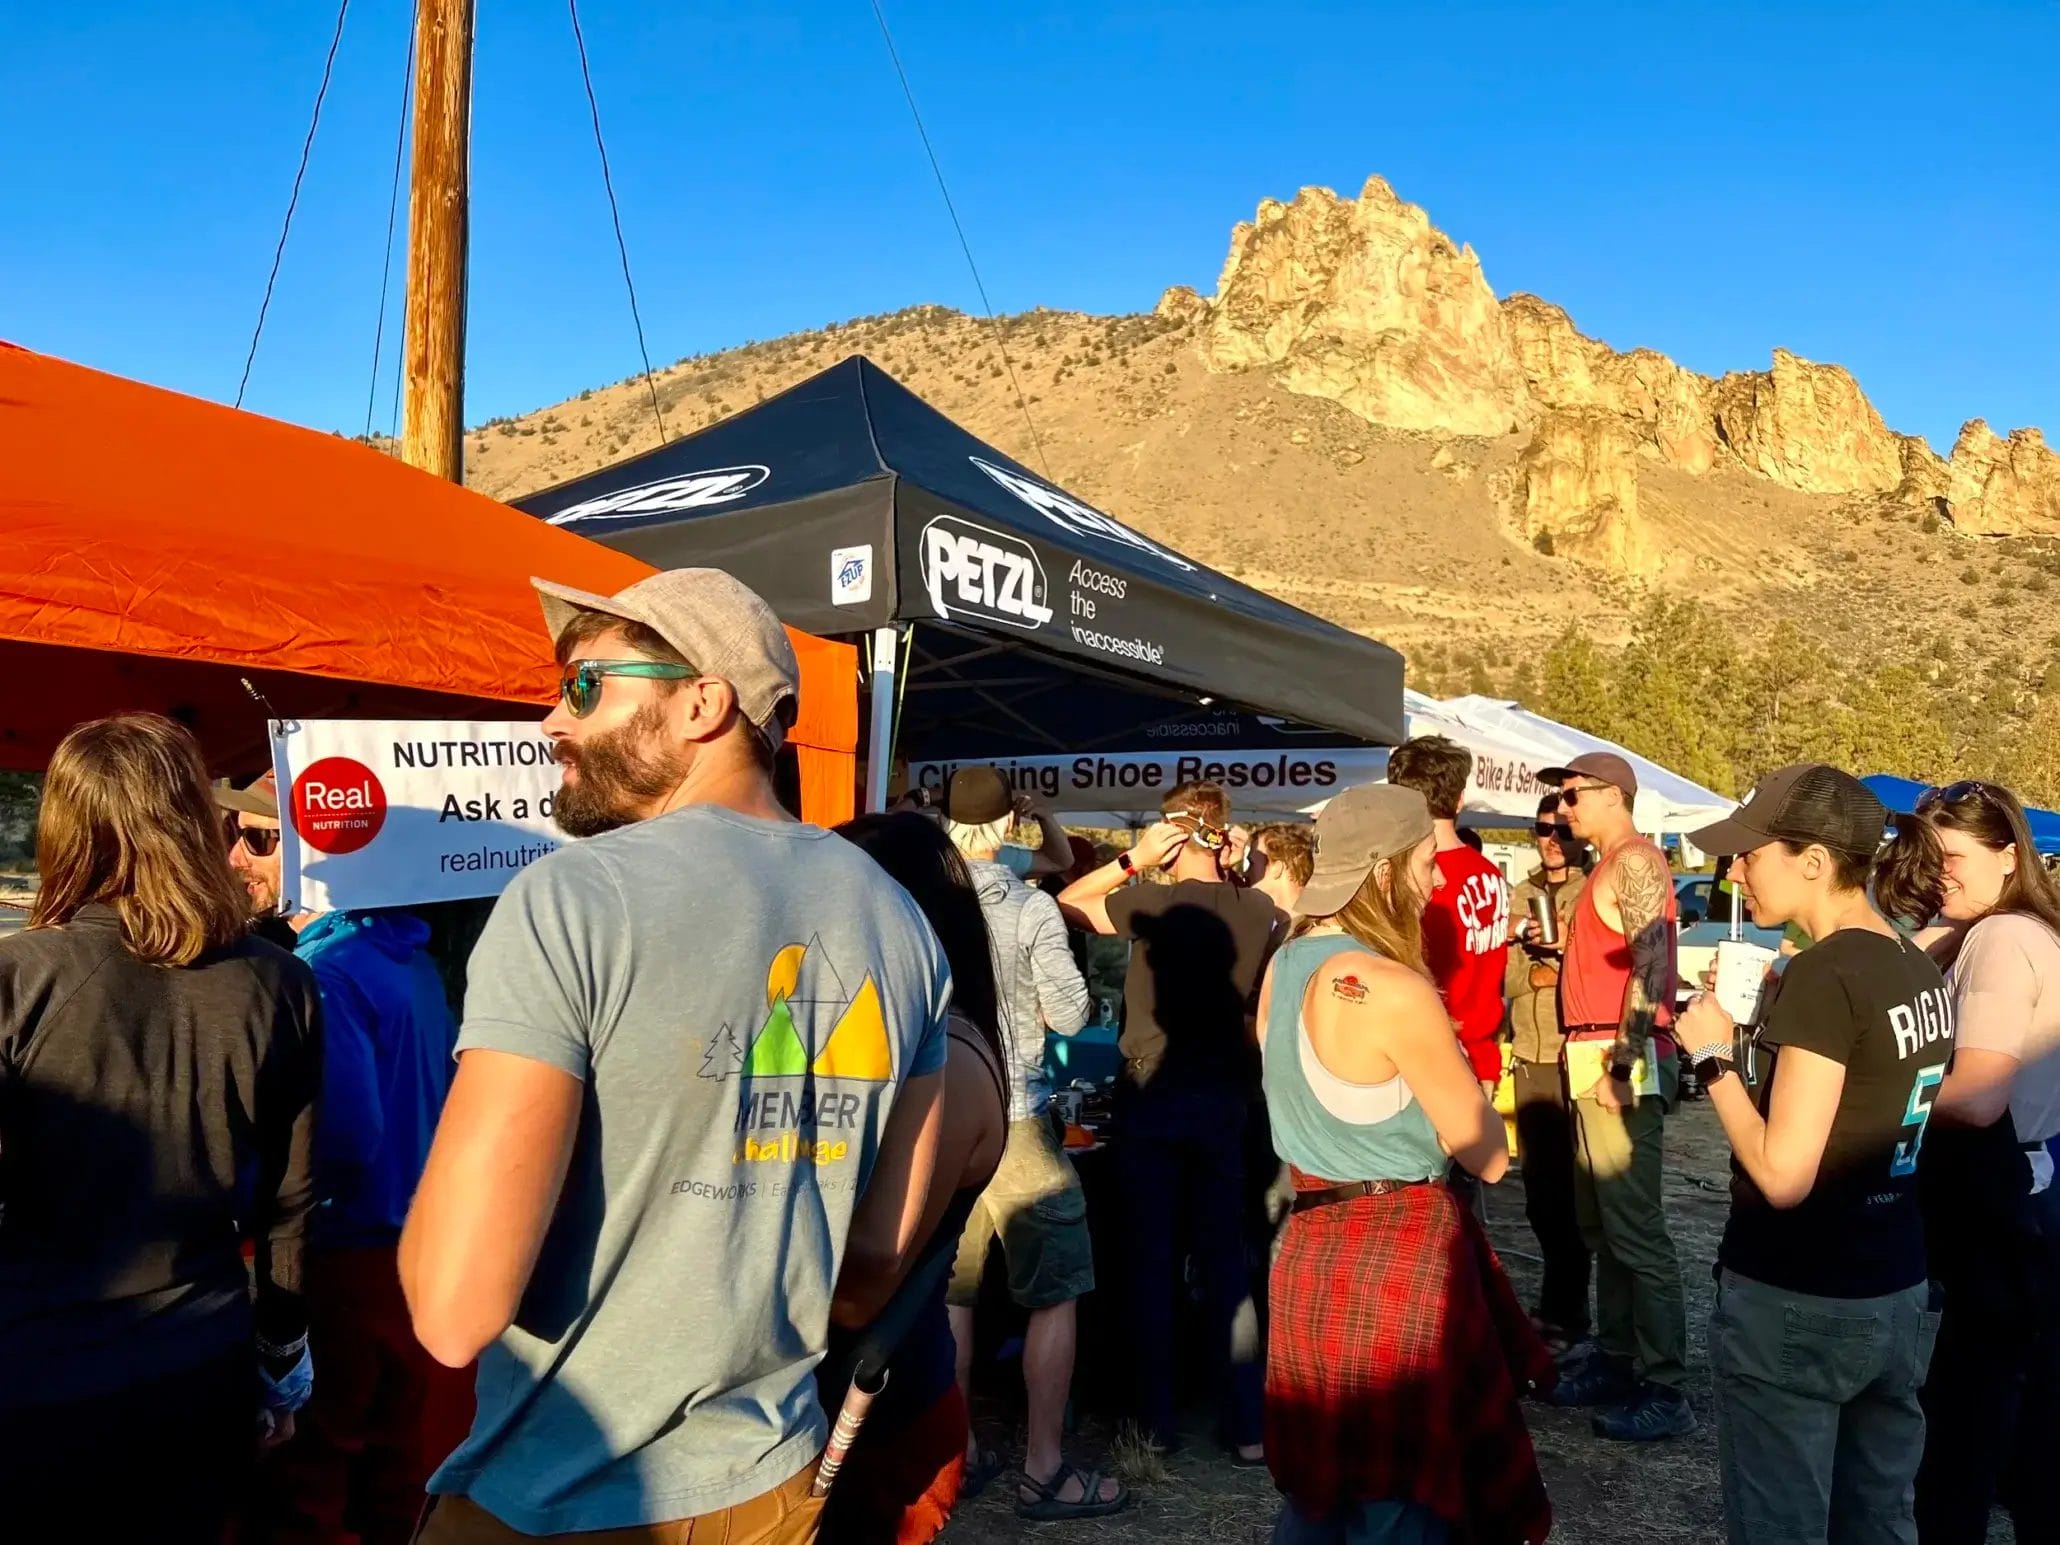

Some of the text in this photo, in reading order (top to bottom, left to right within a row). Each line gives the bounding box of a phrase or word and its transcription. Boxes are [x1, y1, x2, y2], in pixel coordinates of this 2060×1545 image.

[926, 526, 1054, 620] PETZL
[1069, 559, 1127, 599] Access
[1070, 590, 1096, 619] the
[393, 741, 555, 768] NUTRITION
[918, 754, 1337, 798] Cling Shoe Resoles
[1476, 755, 1503, 791] Bike
[1504, 761, 1514, 792] &
[304, 780, 373, 811] Real
[440, 794, 502, 823] Ask
[513, 798, 529, 819] a
[312, 819, 369, 831] NUTRITION
[1887, 987, 1955, 1060] RIGU
[732, 1129, 848, 1166] hallge
[670, 1179, 757, 1201] EDGEWORKS
